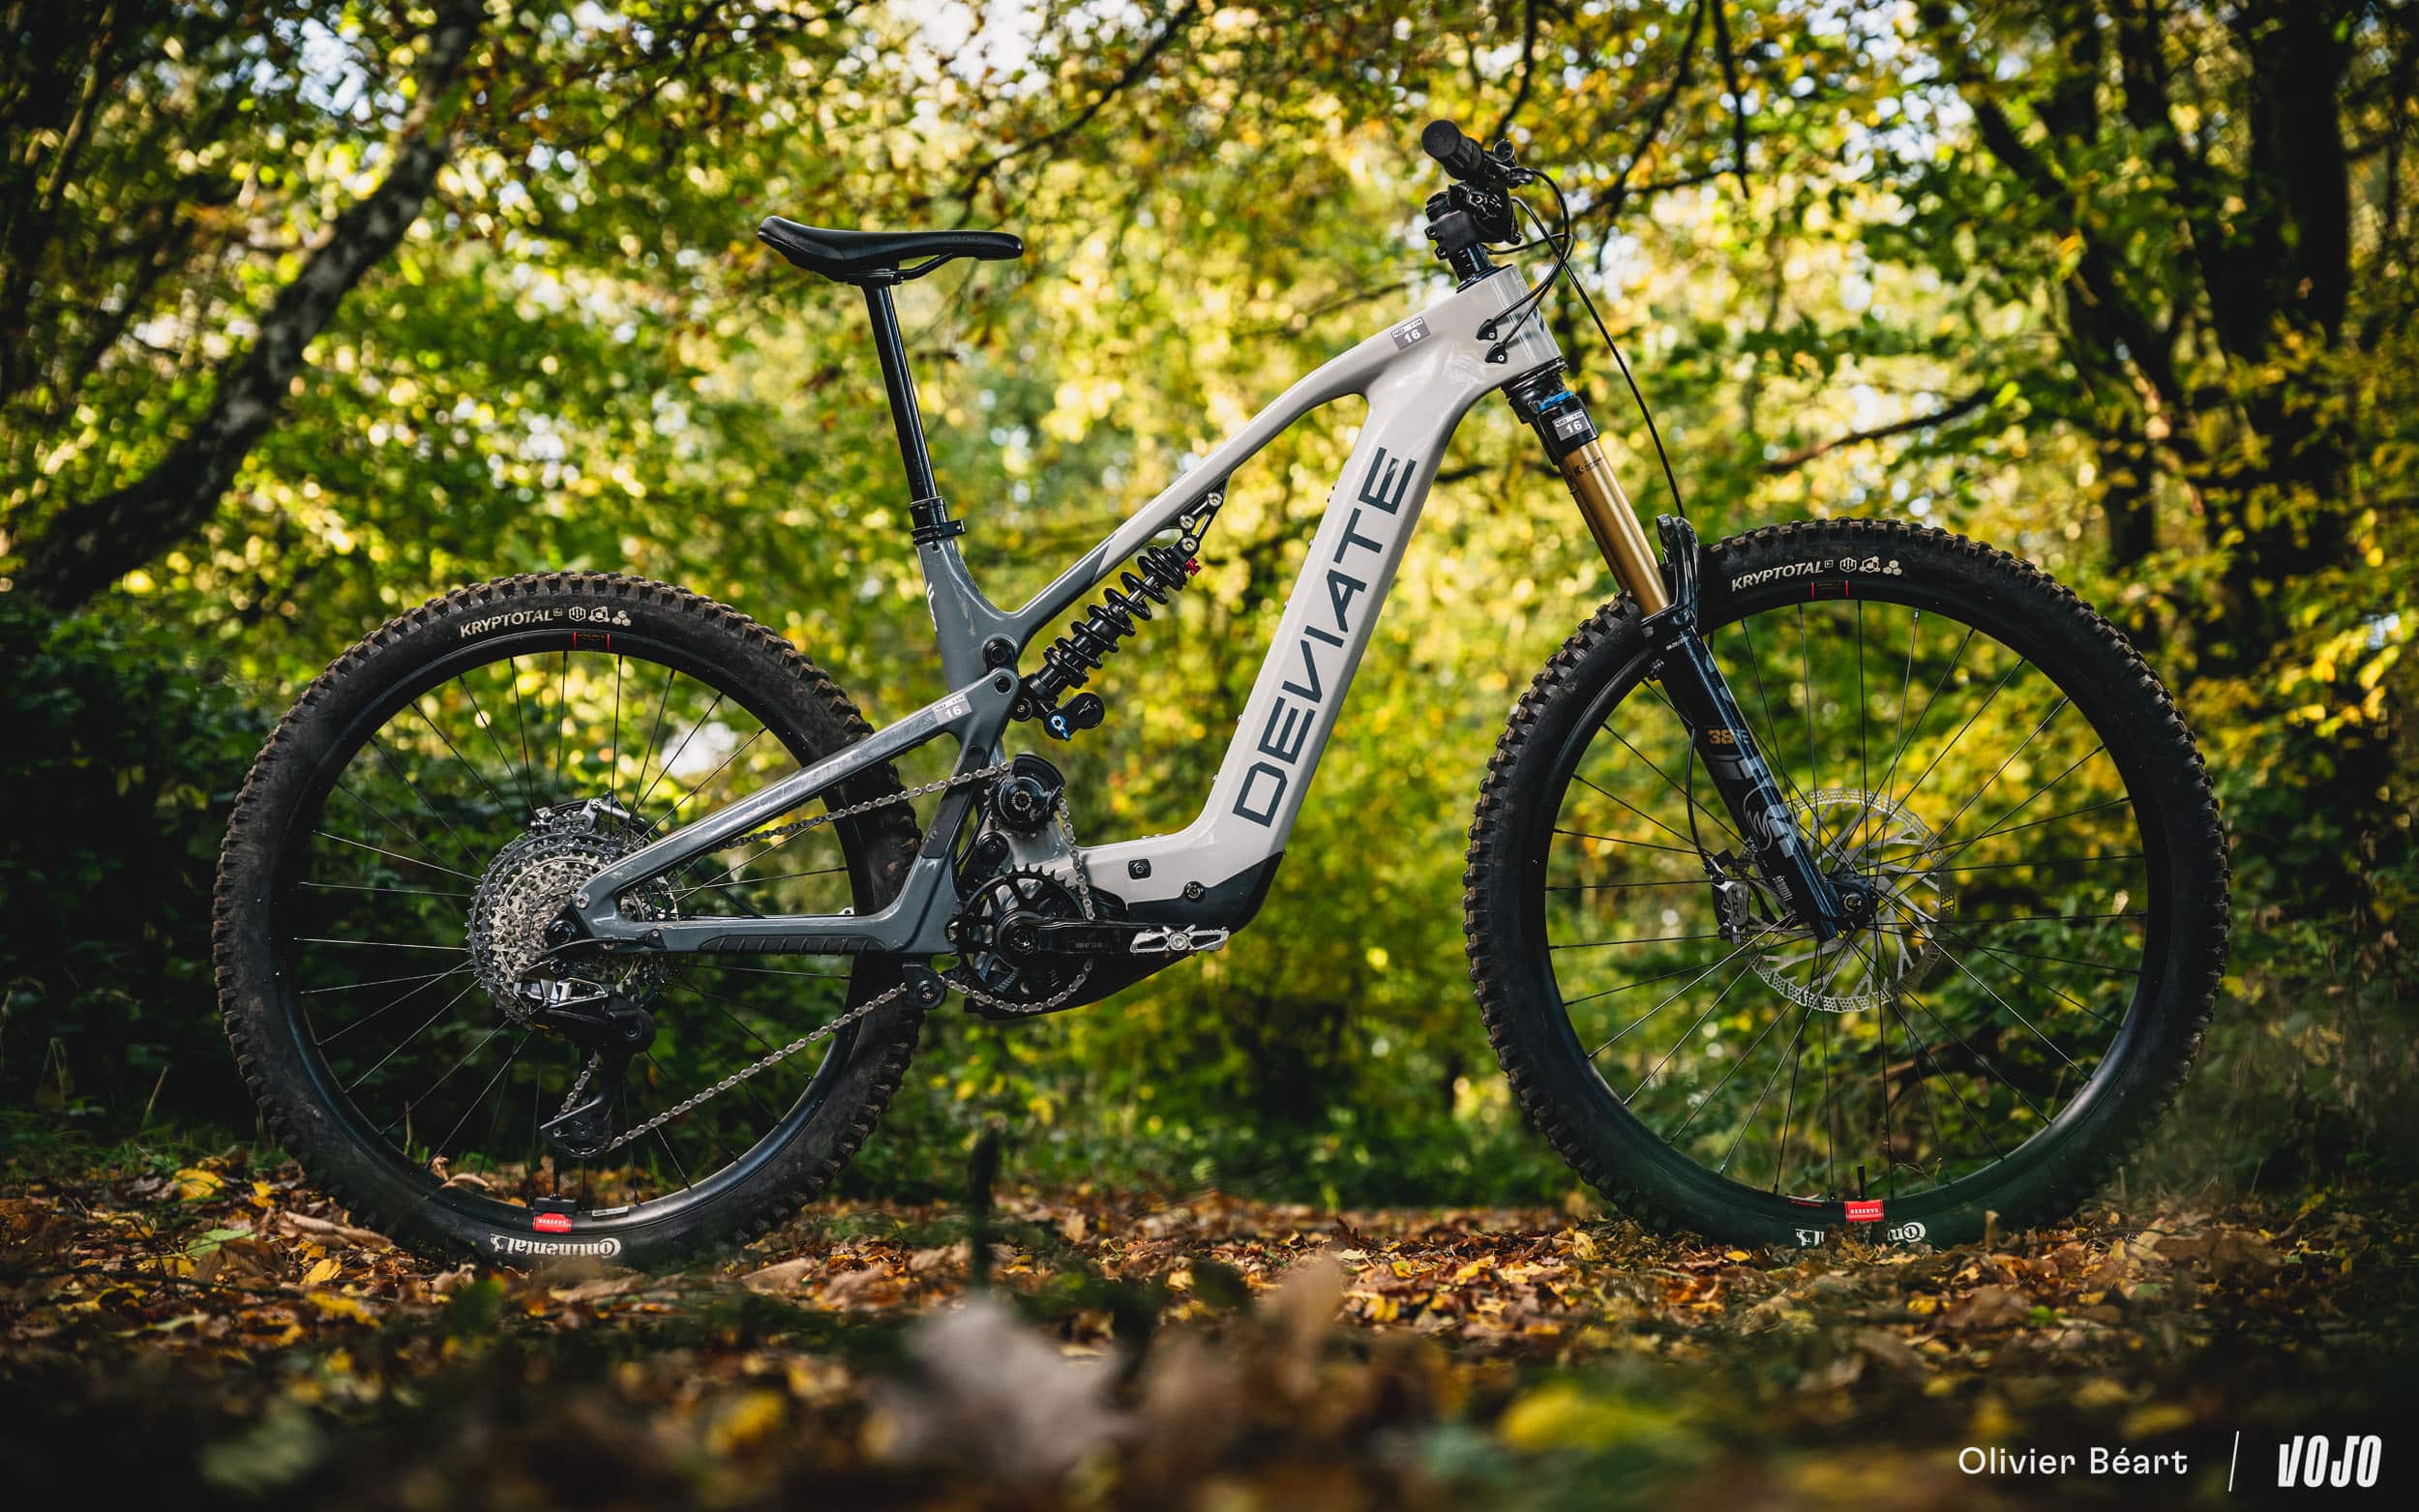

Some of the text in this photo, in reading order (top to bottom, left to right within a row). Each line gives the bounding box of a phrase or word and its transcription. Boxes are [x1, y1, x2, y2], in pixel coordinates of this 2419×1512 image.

[1403, 328, 1421, 344] 16
[1566, 419, 1584, 435] 16
[1731, 560, 1824, 593] KRYPTOTAL
[460, 608, 554, 638] KRYPTOTAL
[1233, 446, 1418, 828] DEVIATE
[944, 704, 963, 720] 16
